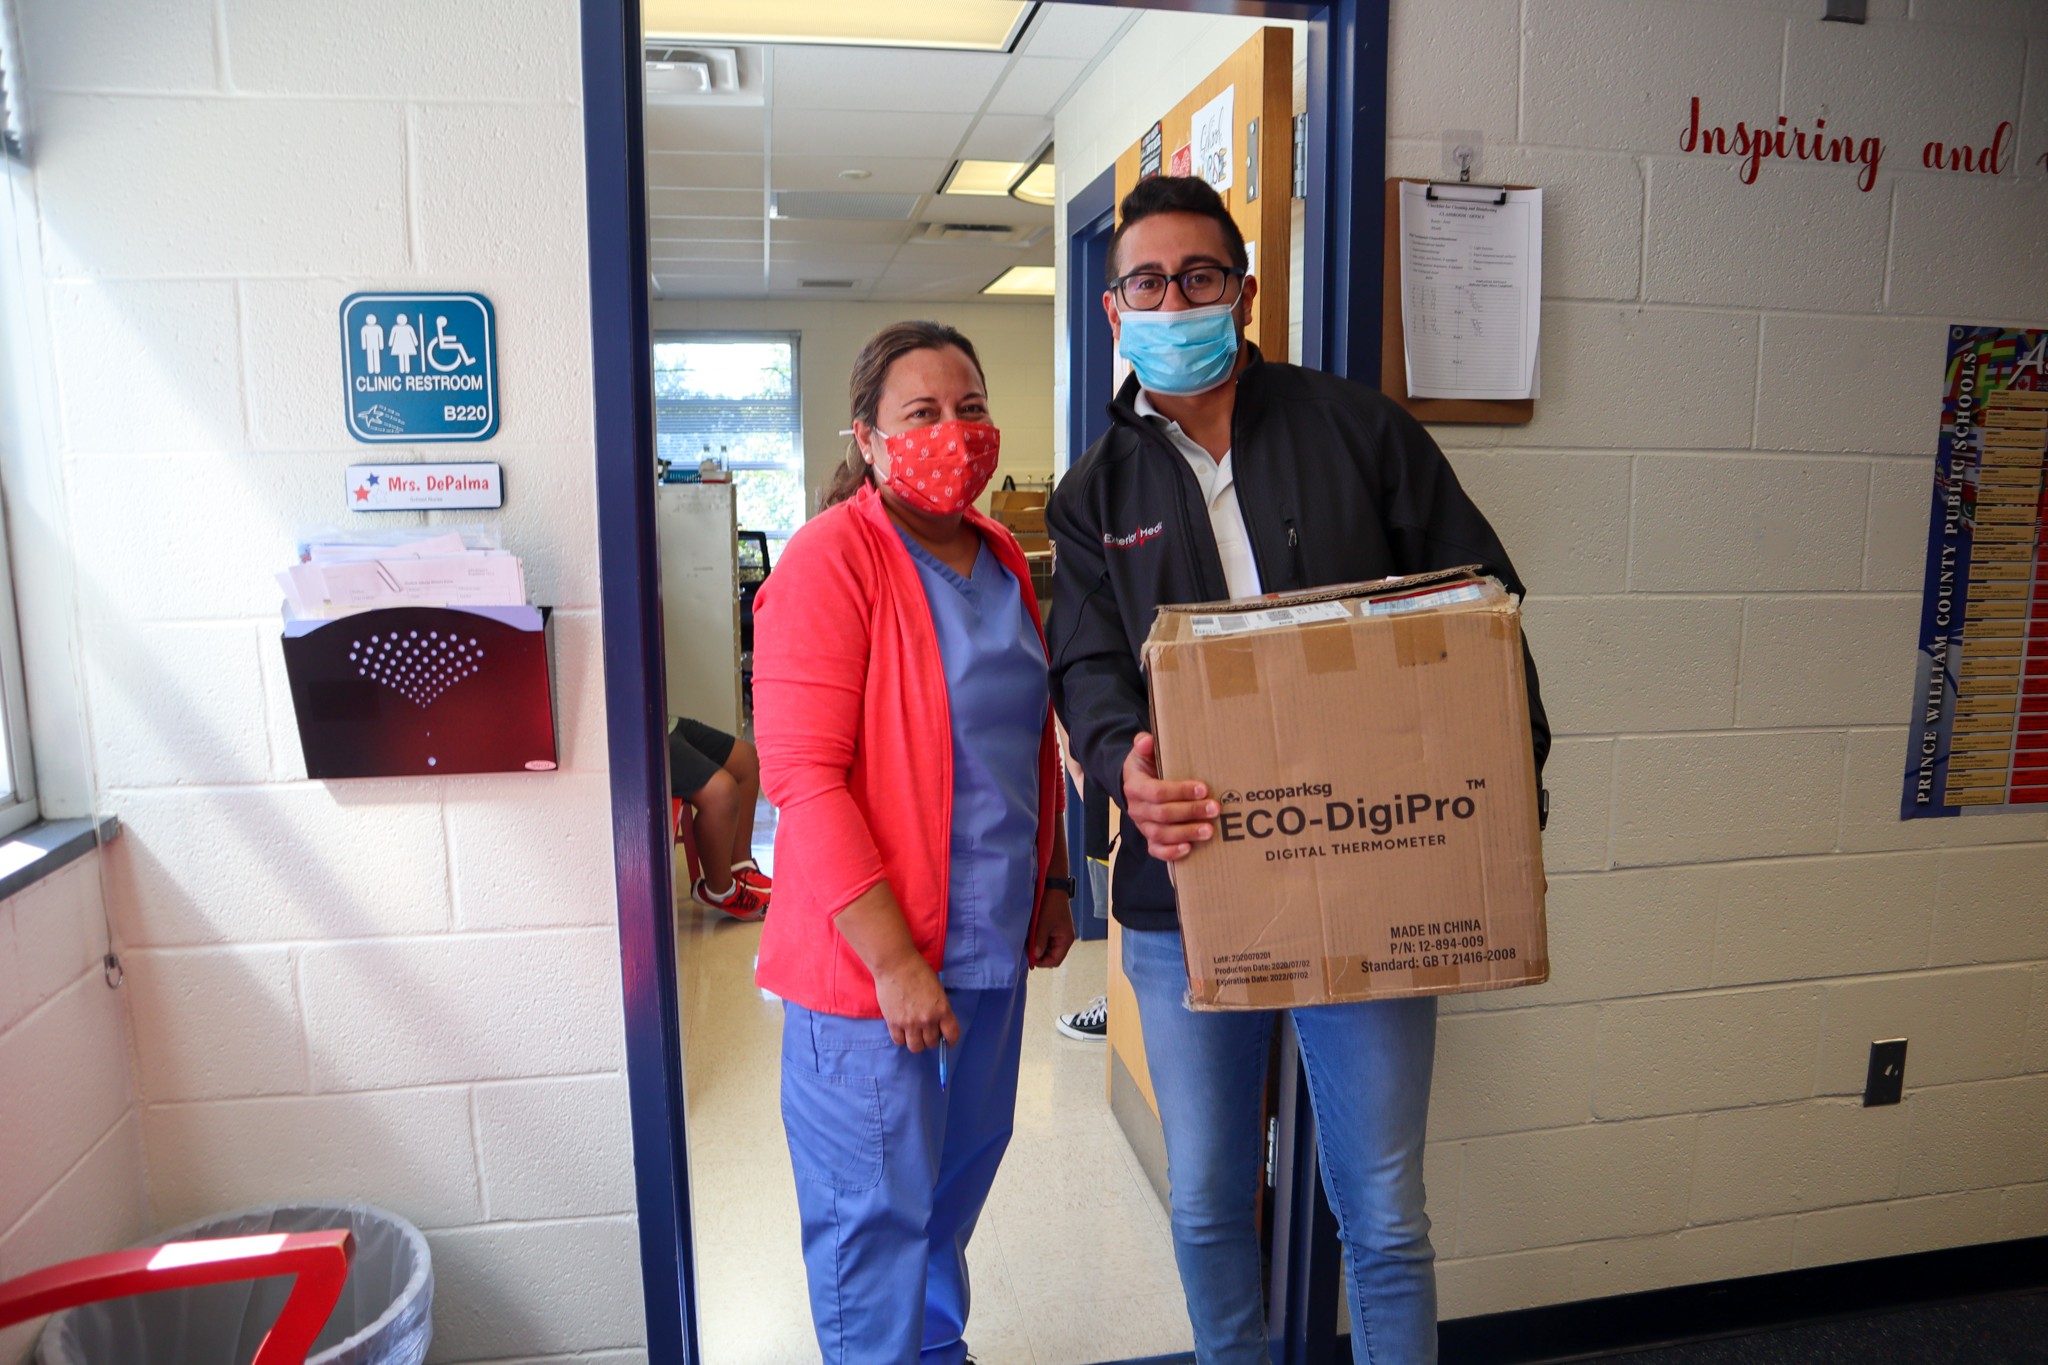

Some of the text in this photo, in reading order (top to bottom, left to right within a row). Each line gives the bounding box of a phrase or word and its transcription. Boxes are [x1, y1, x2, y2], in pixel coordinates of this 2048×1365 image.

[1679, 96, 2014, 192] Inspiring and
[356, 374, 483, 392] CLINIC RESTROOM
[444, 405, 487, 421] B220
[388, 474, 489, 492] Mrs. DePalma
[1916, 352, 1977, 804] PRINCE WILLIAM COUNTY PUBLIC SCHOOLS
[1245, 783, 1333, 803] ecoparksg
[1220, 793, 1475, 842] ECO-DigiPro
[1265, 834, 1447, 861] DIGITAL THERMOMETER
[1390, 919, 1482, 939] MADE IN CHINA
[1390, 935, 1484, 955] P/N: 12-894-009
[1215, 960, 1310, 975] Production Date: 2020/07/02
[1361, 948, 1516, 973] Standard: GB T 21416-2008
[1216, 976, 1250, 987] Expiration
[1251, 974, 1269, 983] Date:
